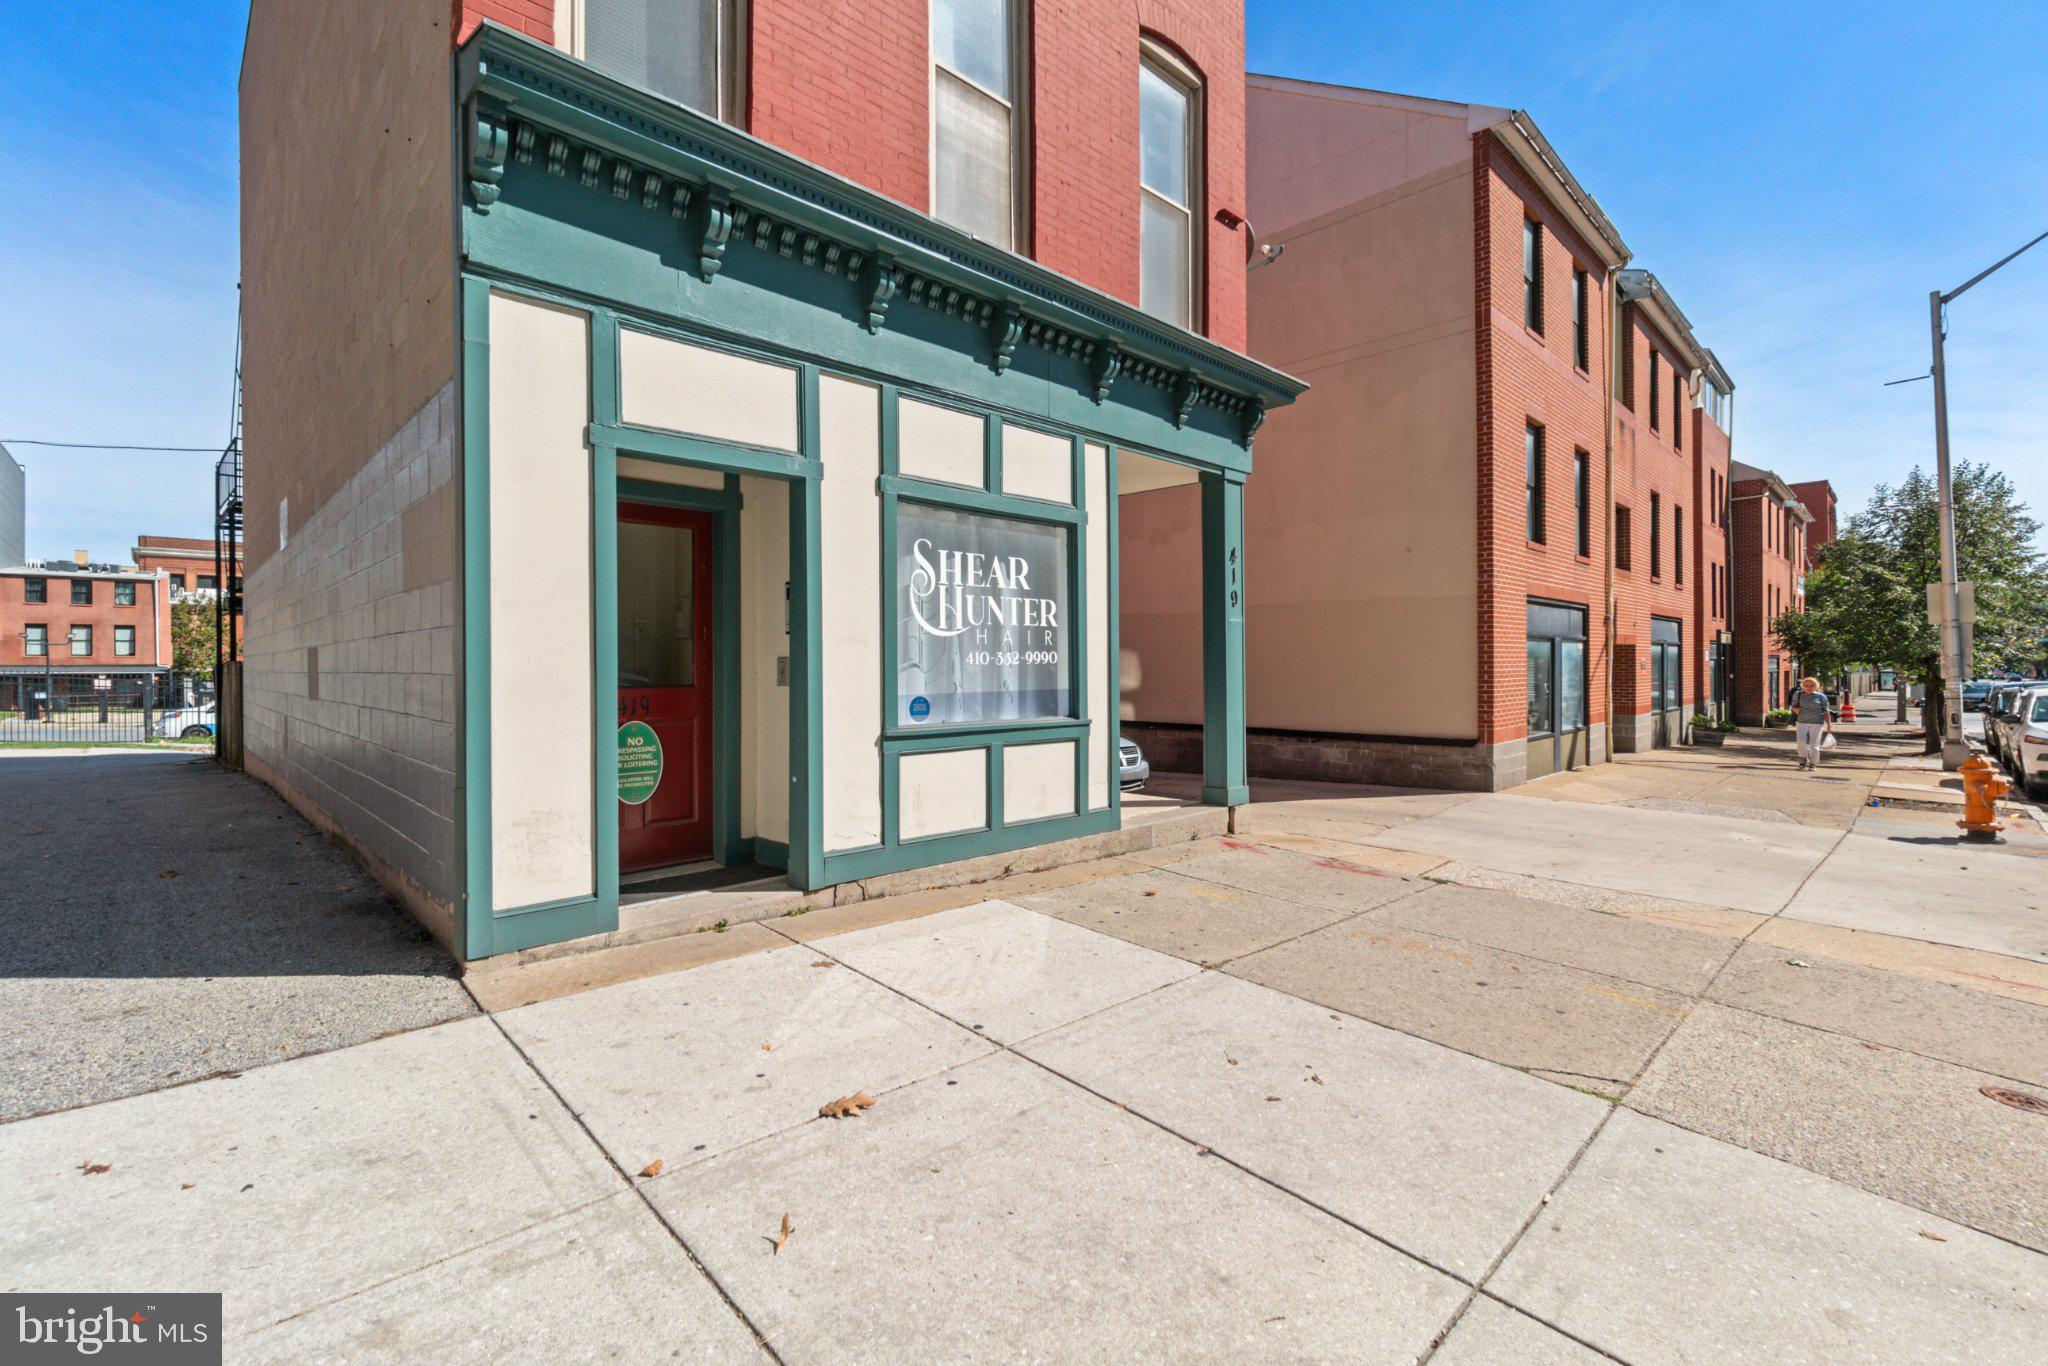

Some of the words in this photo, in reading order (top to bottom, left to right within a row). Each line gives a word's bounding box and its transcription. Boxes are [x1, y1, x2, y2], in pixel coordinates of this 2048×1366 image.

[910, 538, 1031, 596] SHEAR
[1229, 547, 1239, 608] 419
[936, 584, 1059, 631] HUNTER
[975, 630, 1053, 646] HAIR
[965, 651, 1059, 666] 410-332-9990
[627, 737, 644, 746] NO
[624, 760, 658, 768] LOITERING
